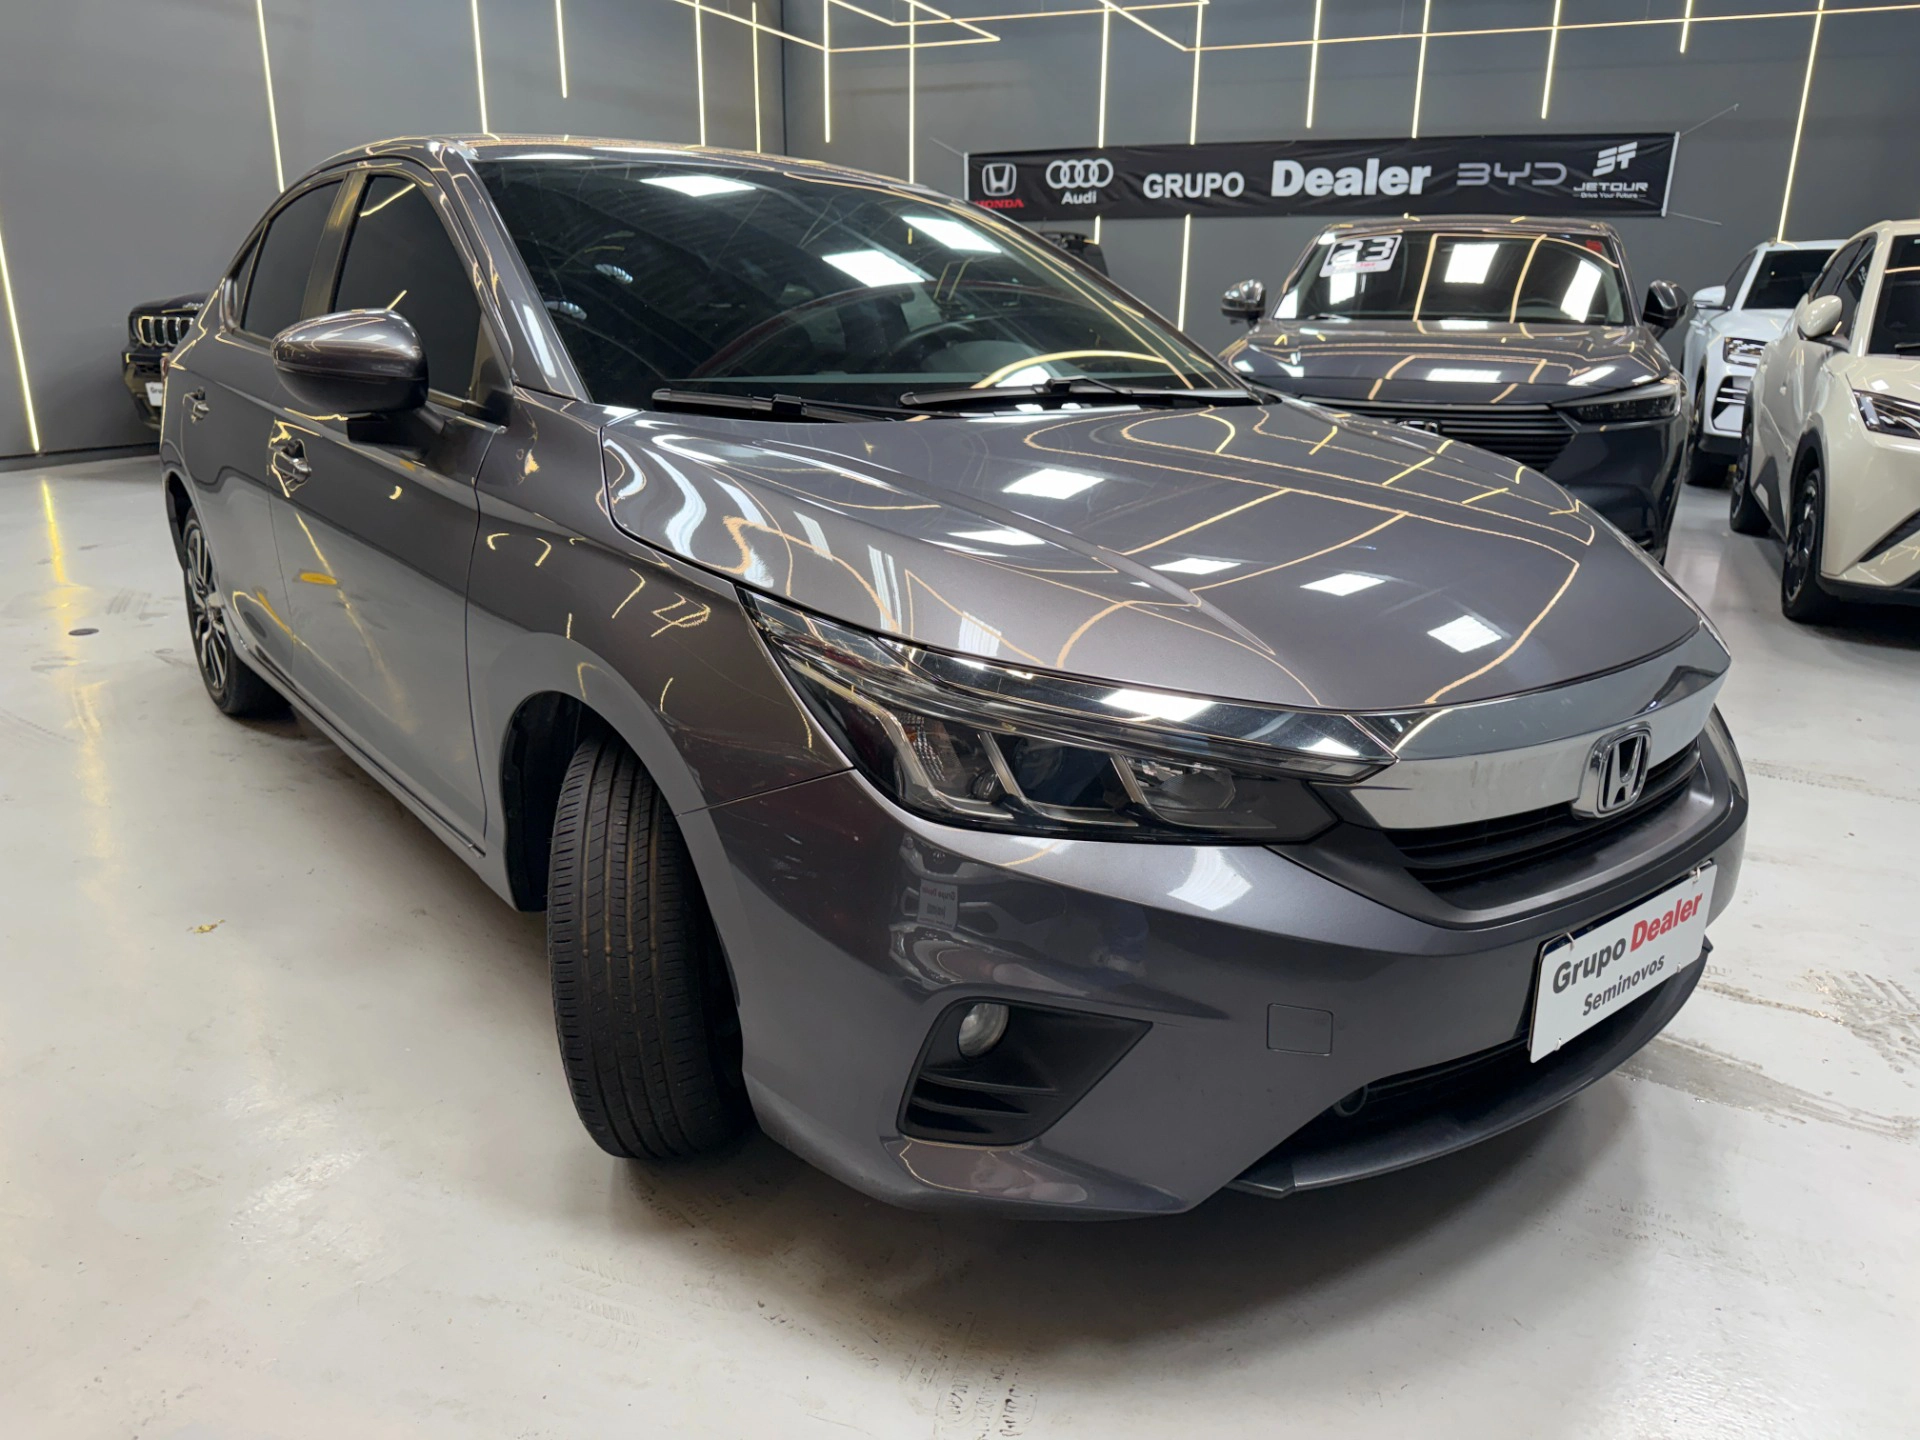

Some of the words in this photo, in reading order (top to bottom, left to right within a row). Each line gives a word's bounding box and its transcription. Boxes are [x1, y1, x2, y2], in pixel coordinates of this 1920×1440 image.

[1142, 171, 1245, 199] GRUPO
[1270, 157, 1432, 198] Dealer
[1456, 162, 1567, 187] BYD
[1572, 181, 1649, 192] JETOUR
[1061, 190, 1097, 205] Audi
[1330, 237, 1396, 263] 23
[1552, 937, 1627, 994] Grupo
[1629, 892, 1703, 953] Dealer
[1582, 954, 1665, 1017] Seminovos
